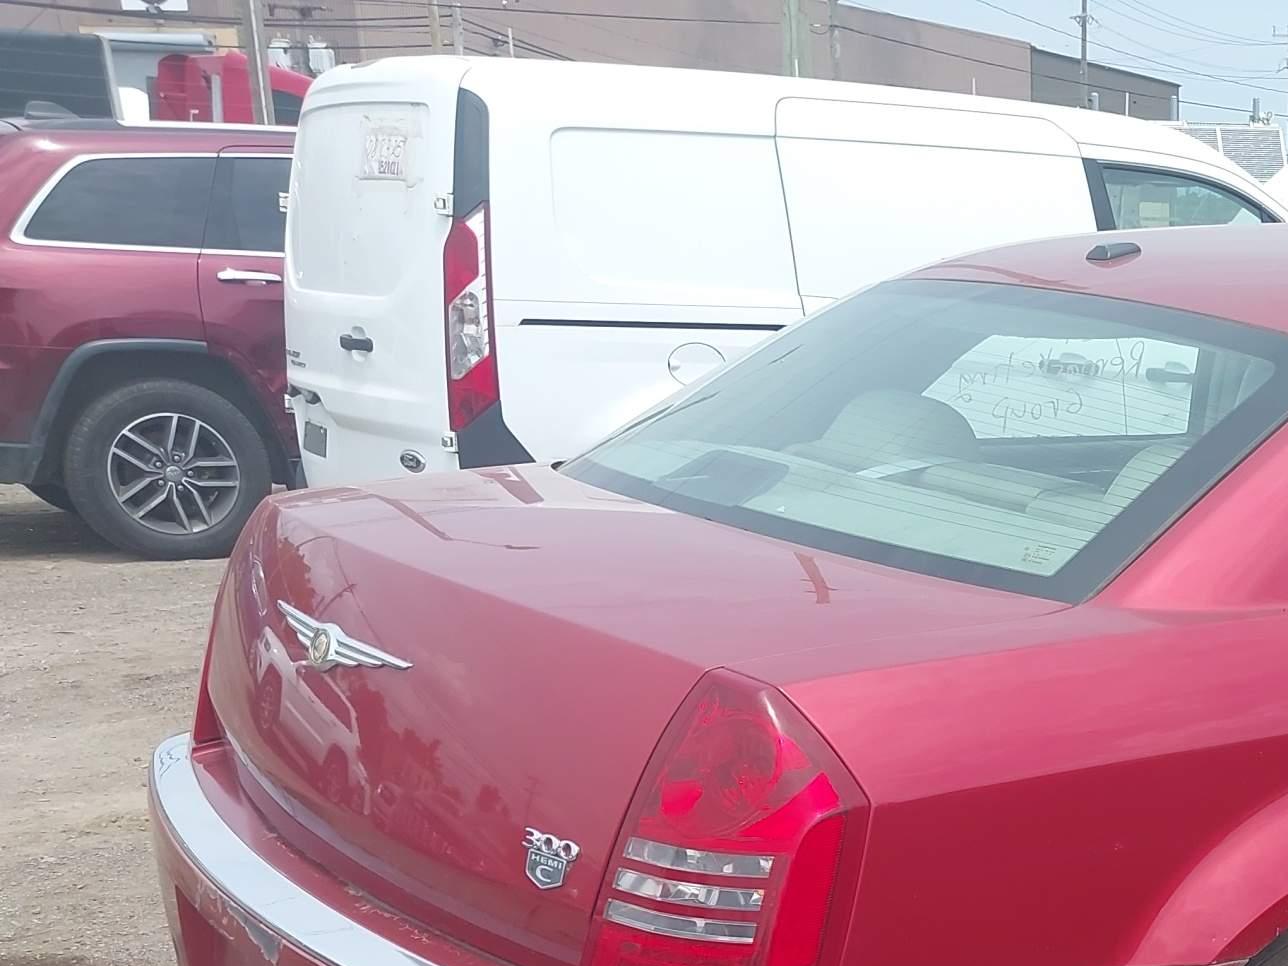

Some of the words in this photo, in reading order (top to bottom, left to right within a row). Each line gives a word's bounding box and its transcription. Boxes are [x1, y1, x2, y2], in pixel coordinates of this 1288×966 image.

[521, 827, 580, 861] 300
[530, 853, 563, 869] HEMI
[535, 865, 554, 882] C
